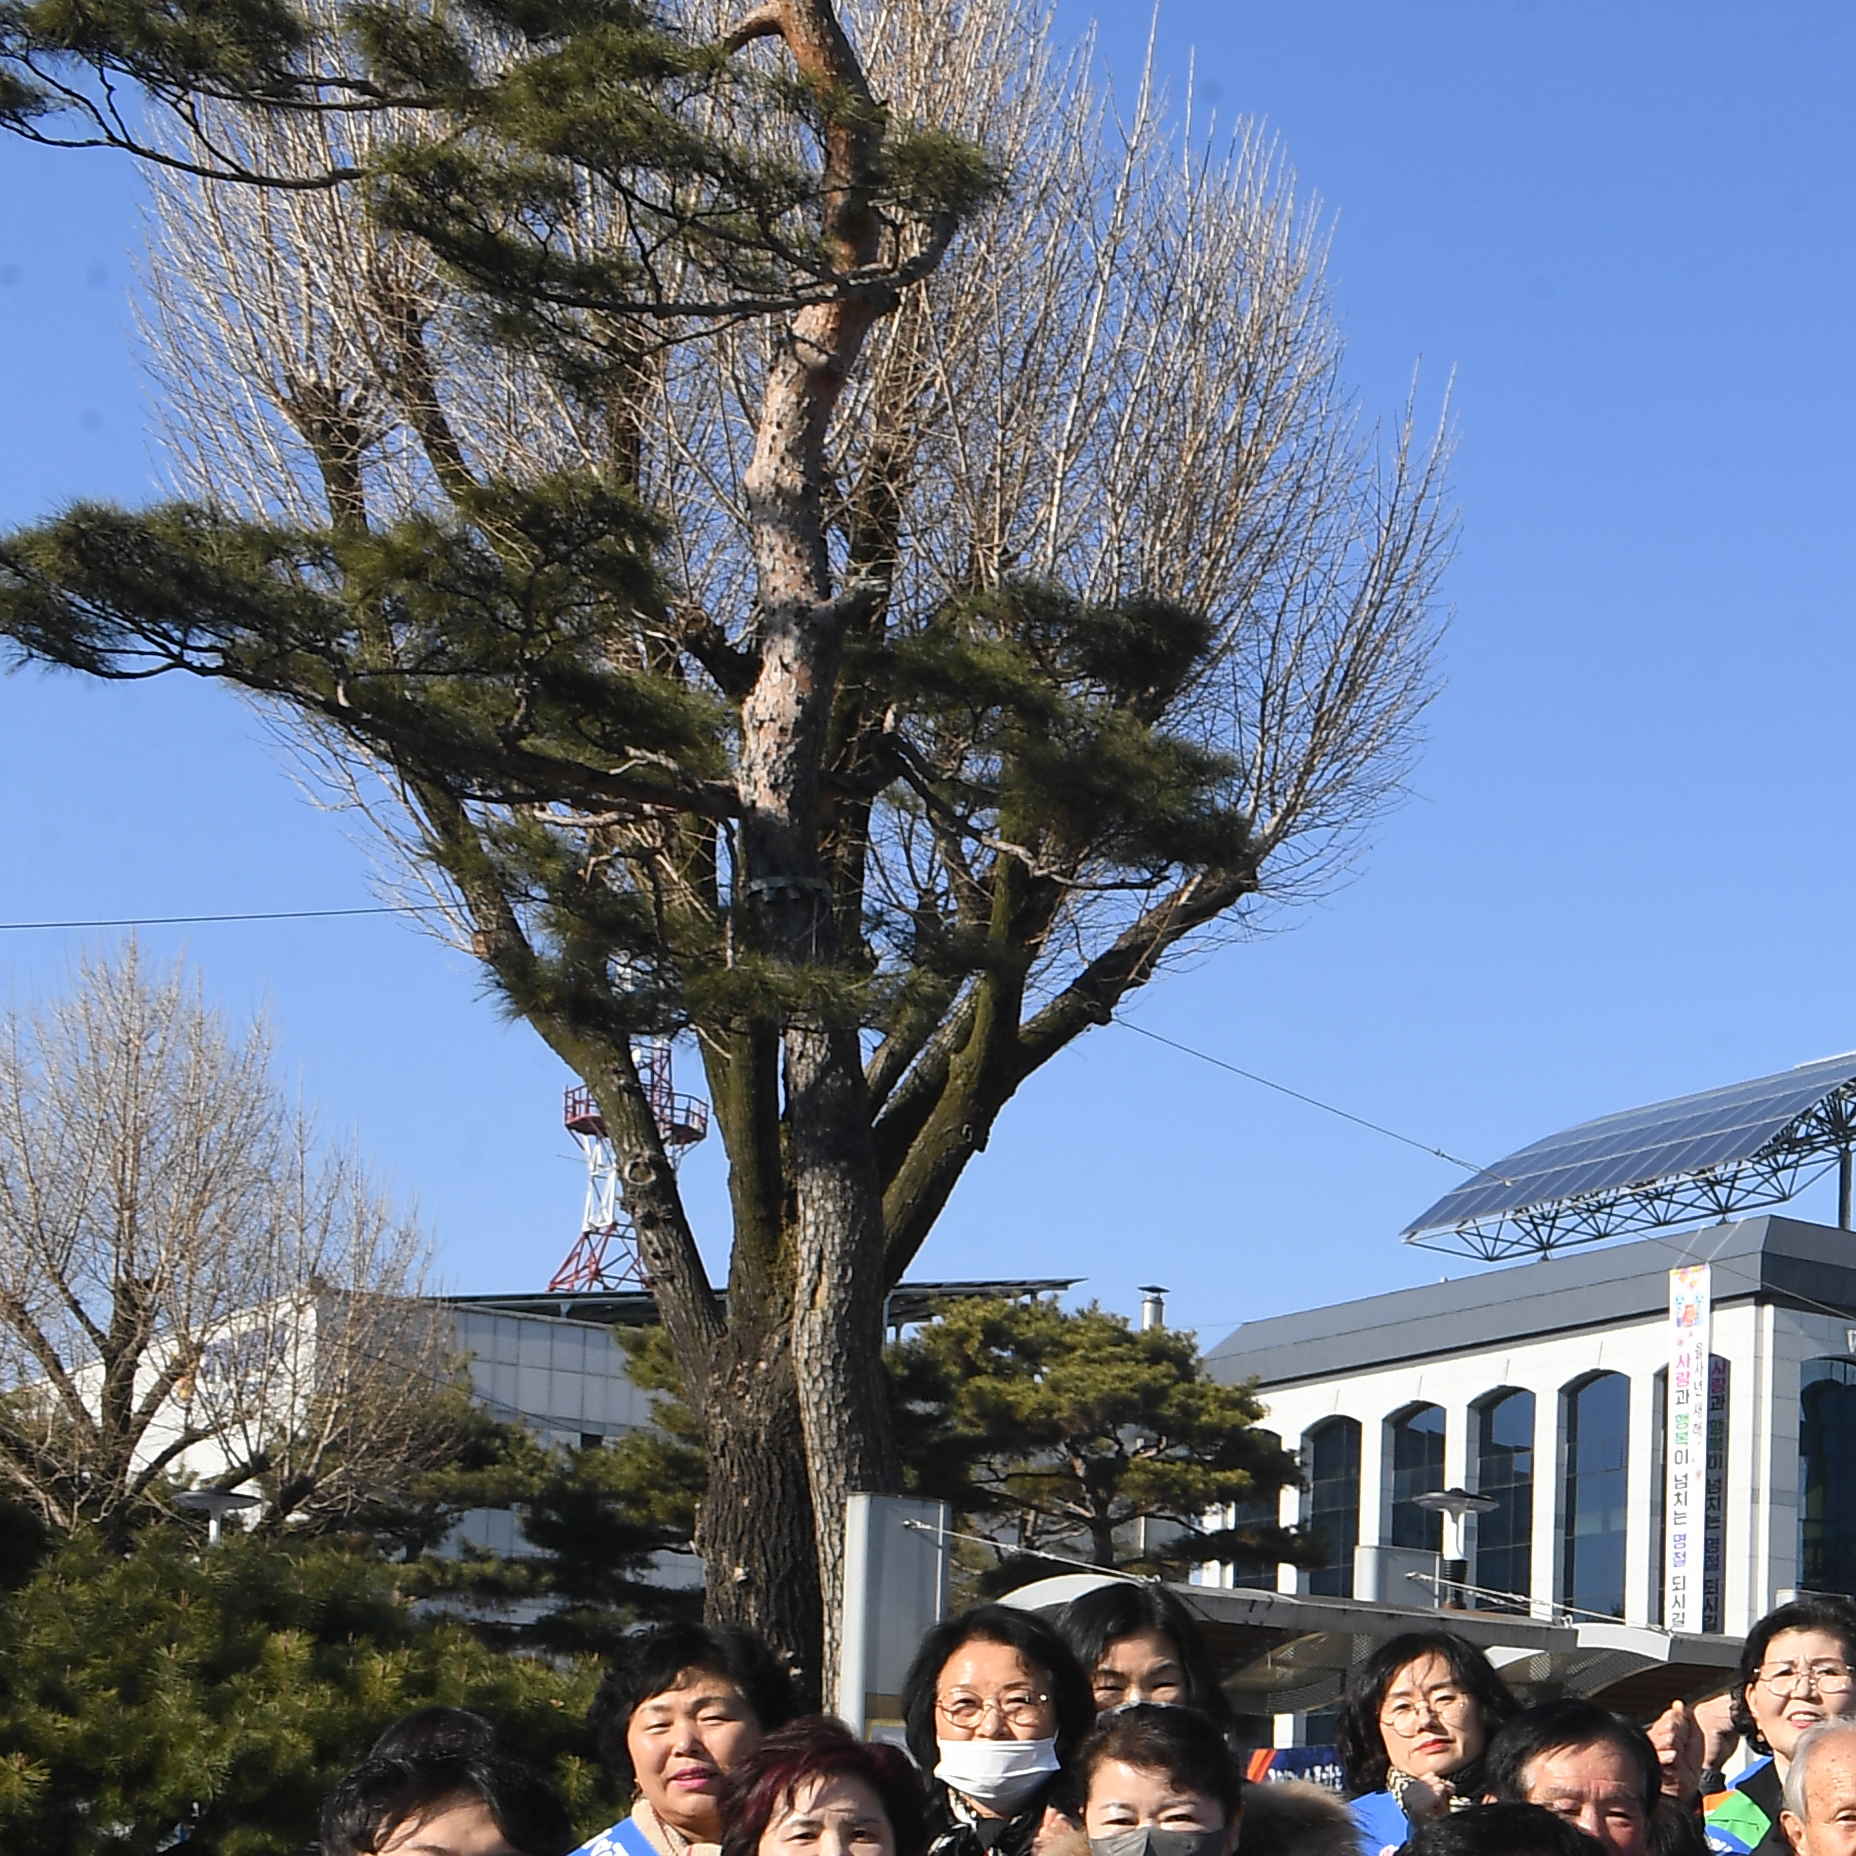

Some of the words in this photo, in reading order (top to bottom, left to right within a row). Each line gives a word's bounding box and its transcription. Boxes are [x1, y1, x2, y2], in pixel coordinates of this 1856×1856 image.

[1675, 1353, 1690, 1405] 사랑과
[1674, 1413, 1689, 1465] 행복이
[1673, 1473, 1688, 1526] 넘치는
[1673, 1533, 1686, 1567] 명절
[1671, 1575, 1686, 1628] 되시길
